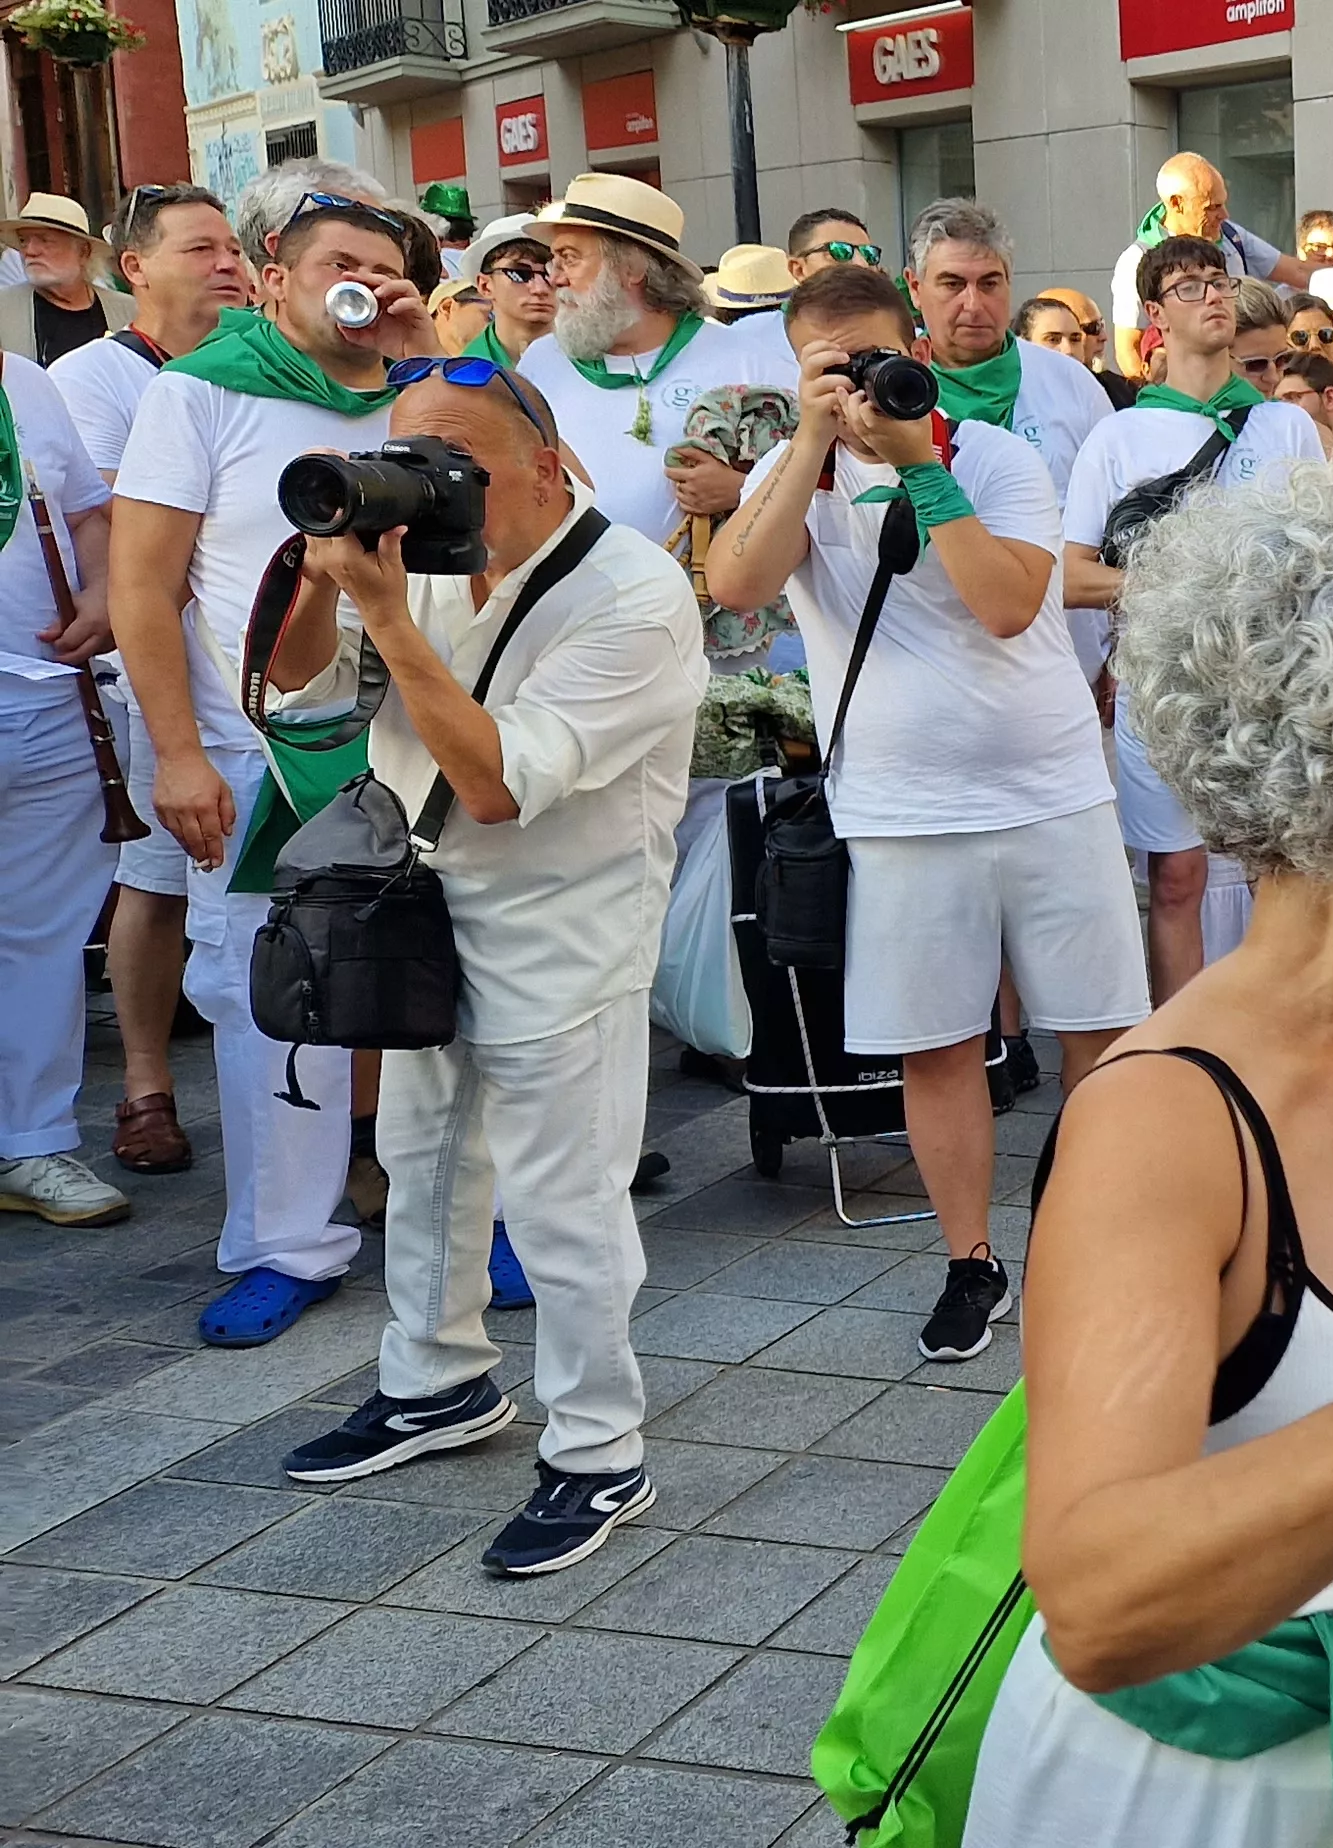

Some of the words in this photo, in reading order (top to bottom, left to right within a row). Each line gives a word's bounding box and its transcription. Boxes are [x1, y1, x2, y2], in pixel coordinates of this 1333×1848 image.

[873, 28, 940, 84] GAES
[500, 112, 539, 154] GAES
[383, 443, 411, 453] Canon
